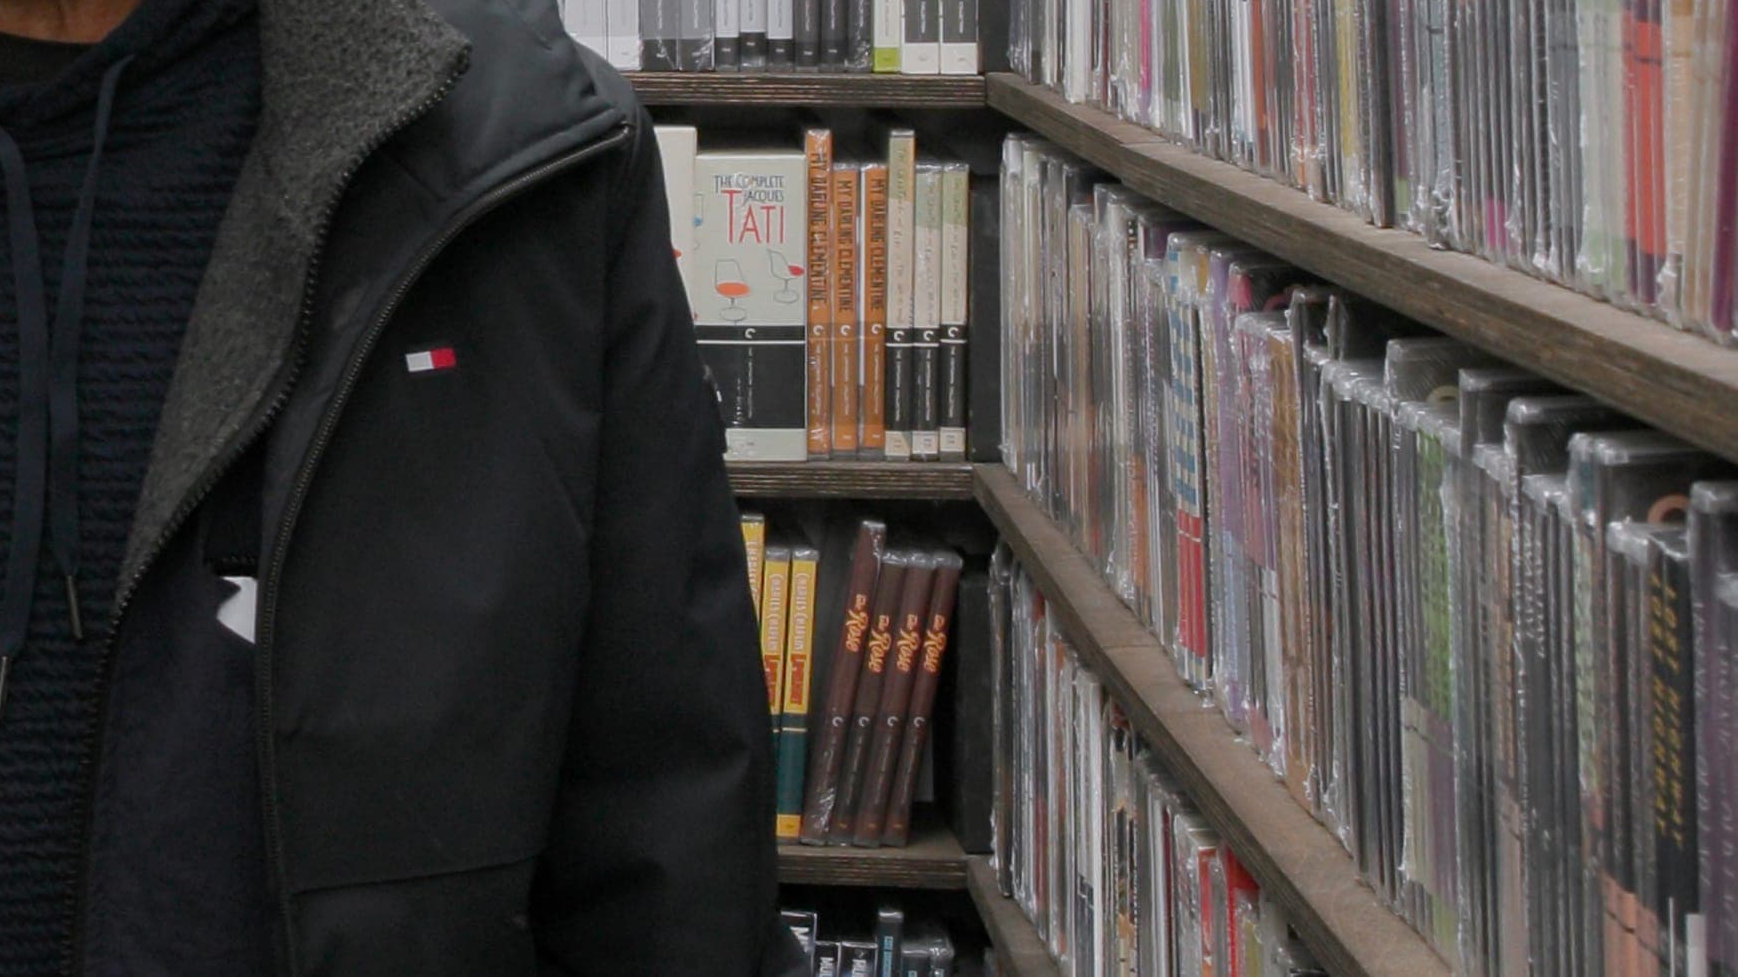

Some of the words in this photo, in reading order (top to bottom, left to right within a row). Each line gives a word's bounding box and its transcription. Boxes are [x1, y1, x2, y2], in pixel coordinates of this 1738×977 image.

[734, 174, 785, 187] COMPLETE
[869, 178, 885, 196] MY
[720, 189, 785, 244] TATI
[869, 200, 886, 243] DARLING
[869, 247, 886, 311] CLEMENTINE
[794, 573, 810, 611] CHARLES
[844, 609, 868, 653] Rose
[868, 631, 892, 674] Rose
[896, 631, 920, 674] Rose
[923, 631, 947, 674] Rose
